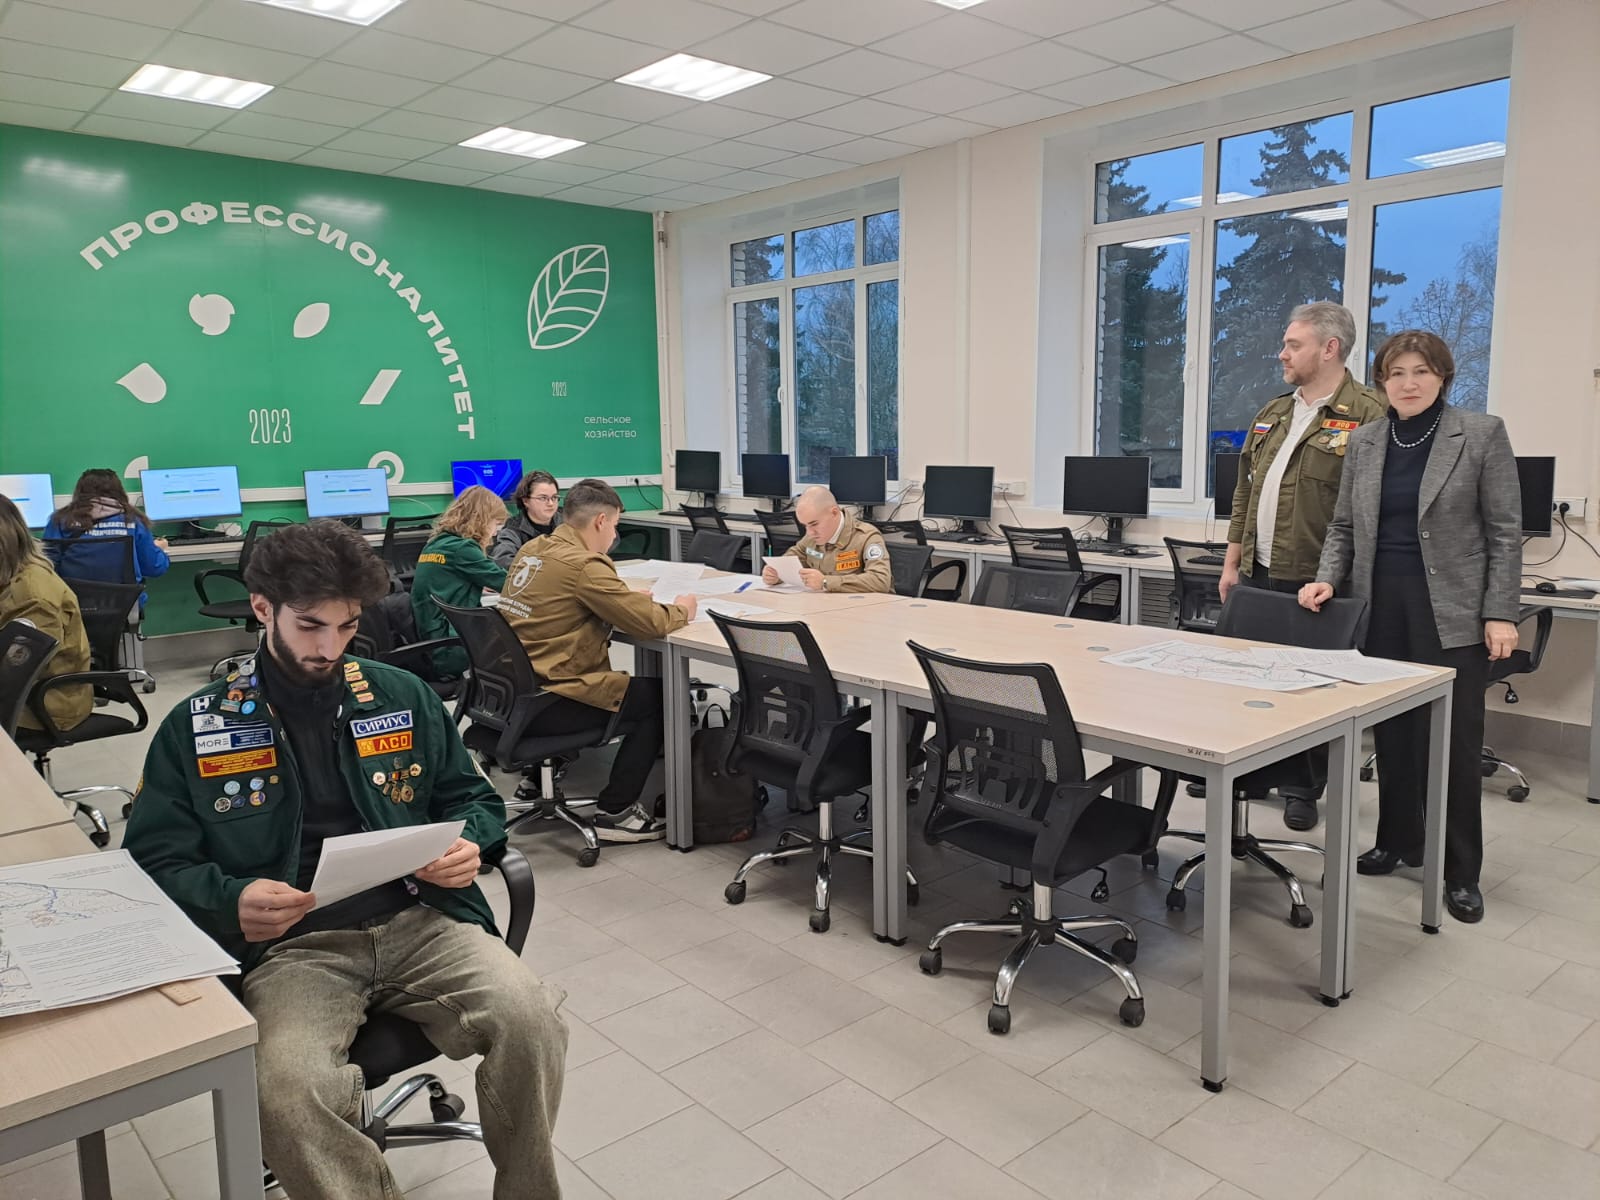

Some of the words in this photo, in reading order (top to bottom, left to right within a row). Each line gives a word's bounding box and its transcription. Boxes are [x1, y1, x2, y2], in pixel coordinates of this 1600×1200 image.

[80, 201, 475, 440] ПРОФЕССИОНАЛИТЕТ
[551, 381, 567, 397] 2023
[249, 408, 292, 444] 2023
[584, 416, 631, 424] сельское
[584, 428, 637, 438] хозяйство
[356, 714, 408, 734] СИРИУС
